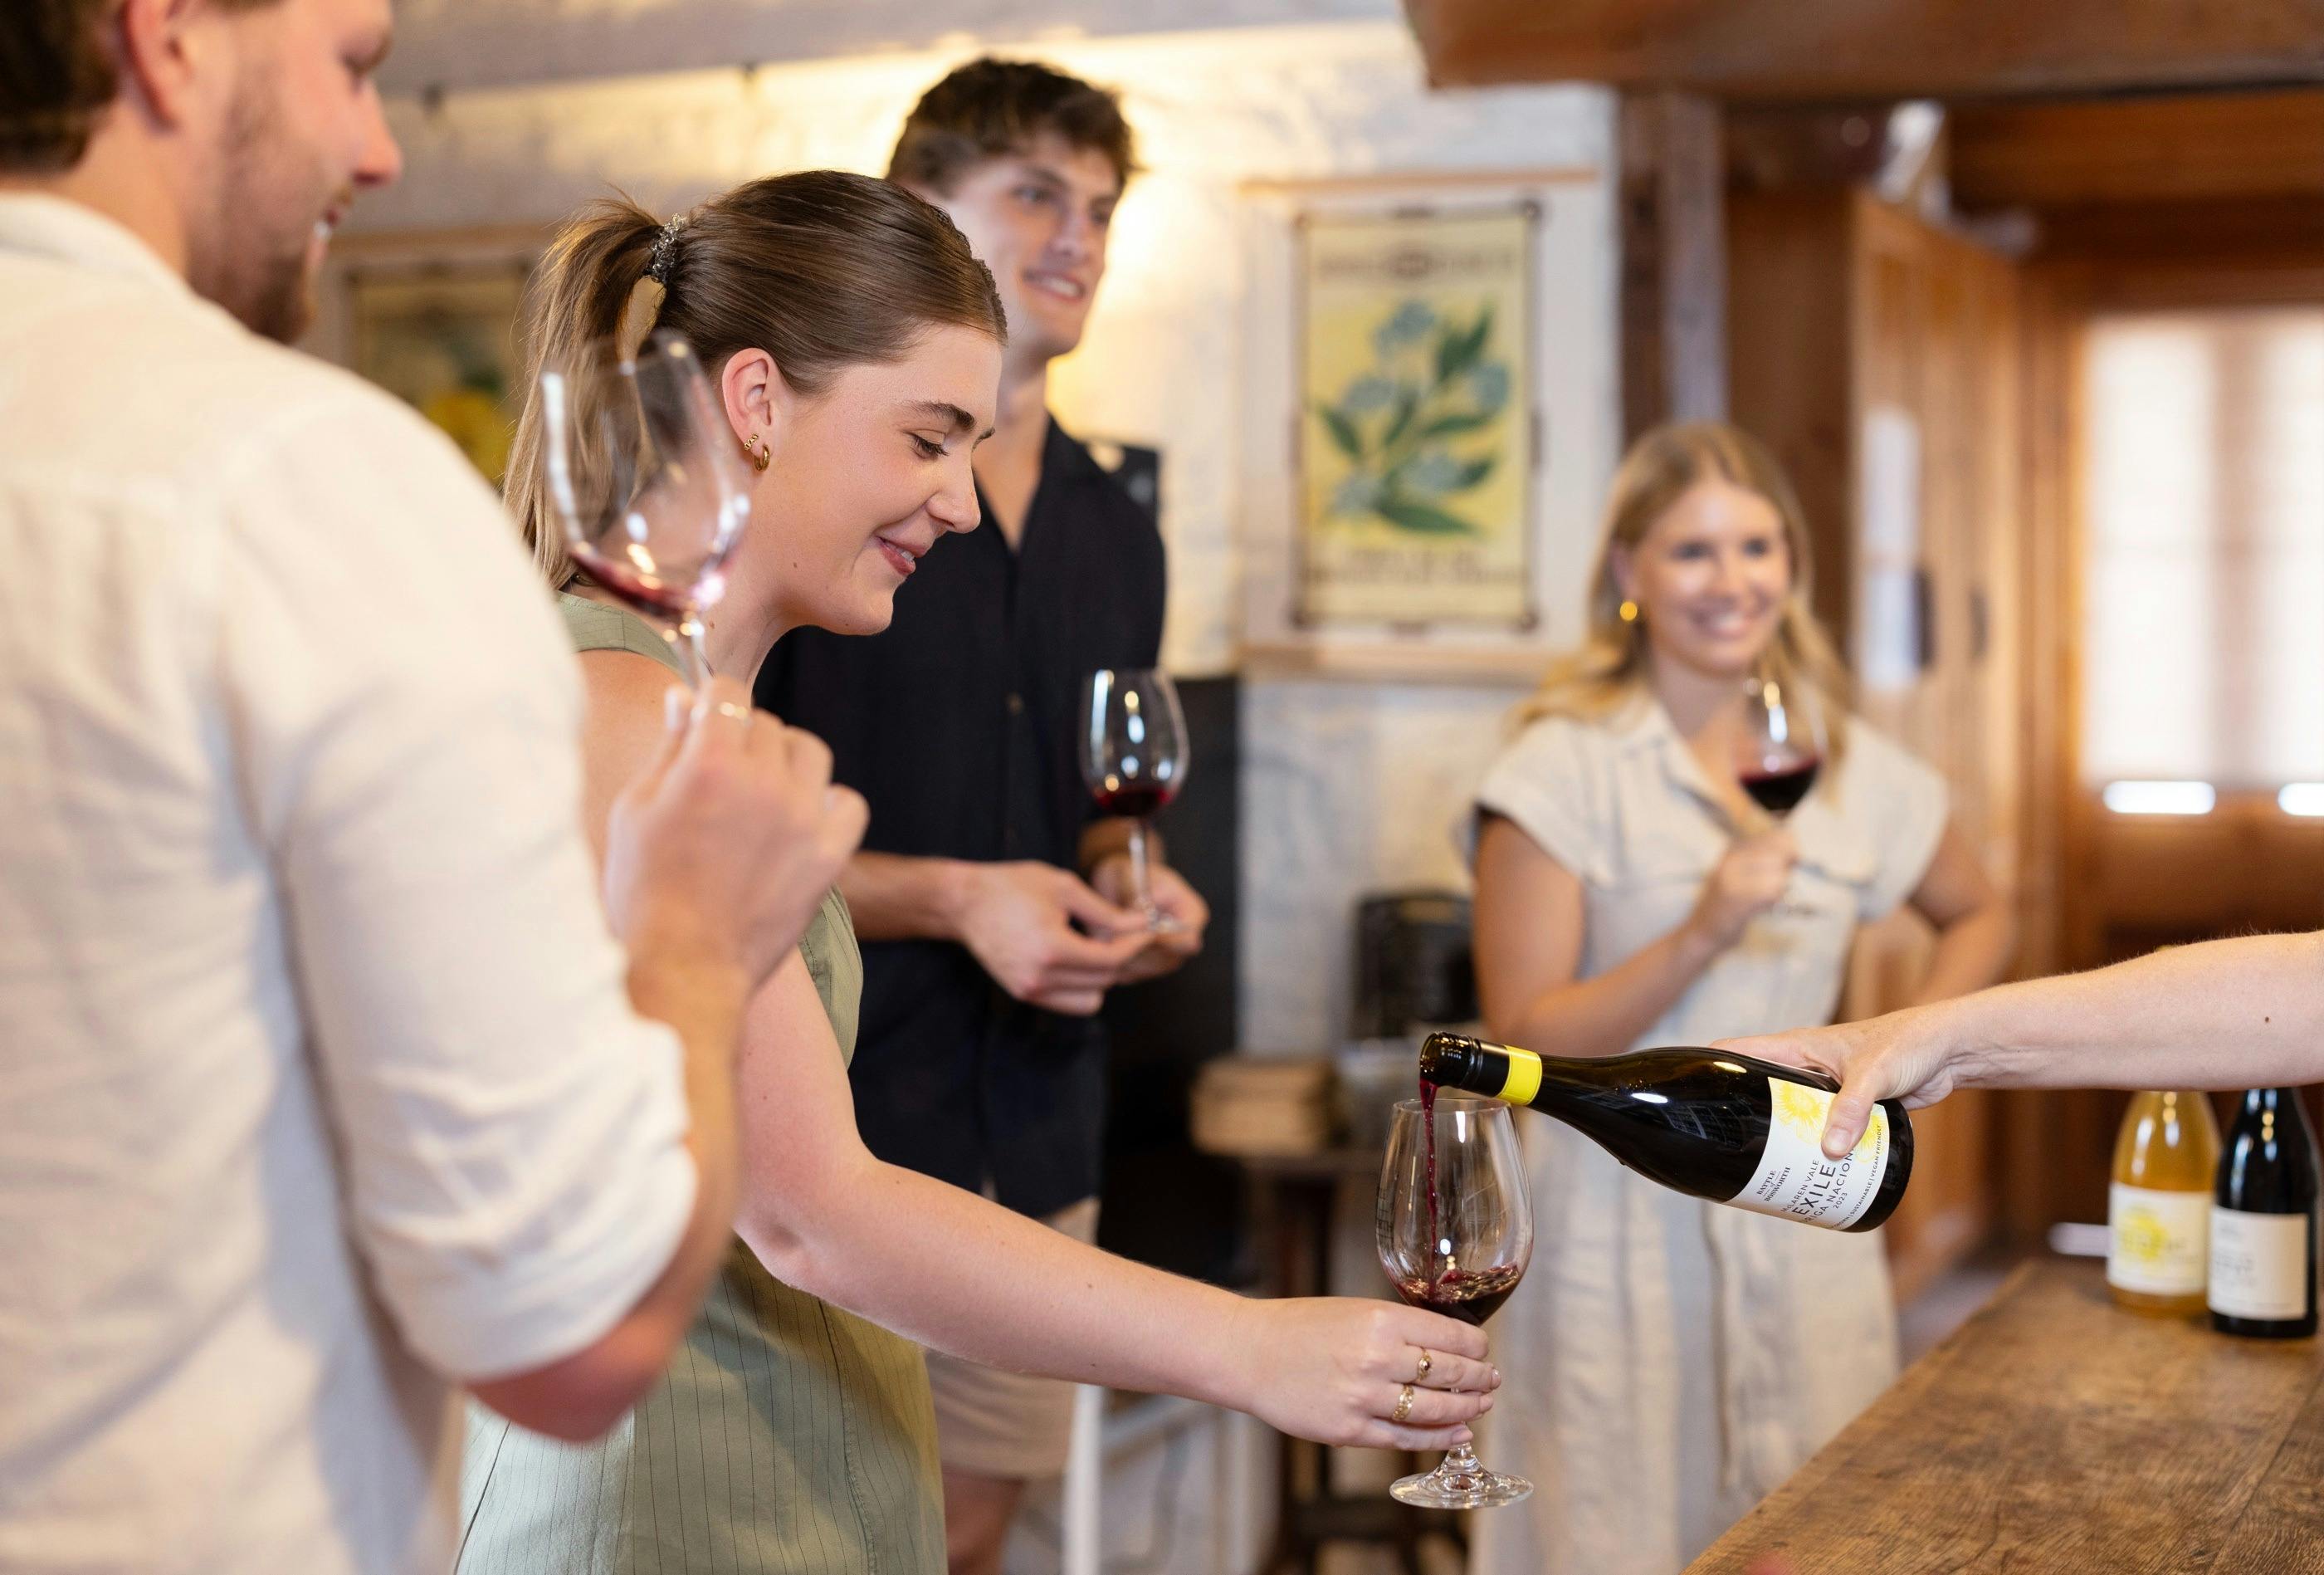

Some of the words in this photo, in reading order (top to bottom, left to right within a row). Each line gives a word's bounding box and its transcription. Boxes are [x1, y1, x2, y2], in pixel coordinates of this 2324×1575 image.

[1756, 1171, 1776, 1195] BATTLE
[1765, 1167, 1790, 1201] BOSWORTH
[1806, 1159, 1819, 1181] VALE
[1791, 1165, 1836, 1215] EXILE
[1850, 1182, 1872, 1215] SUSTAINABLE
[1870, 1156, 1879, 1177] VEGAN
[1833, 1192, 1848, 1209] 2023
